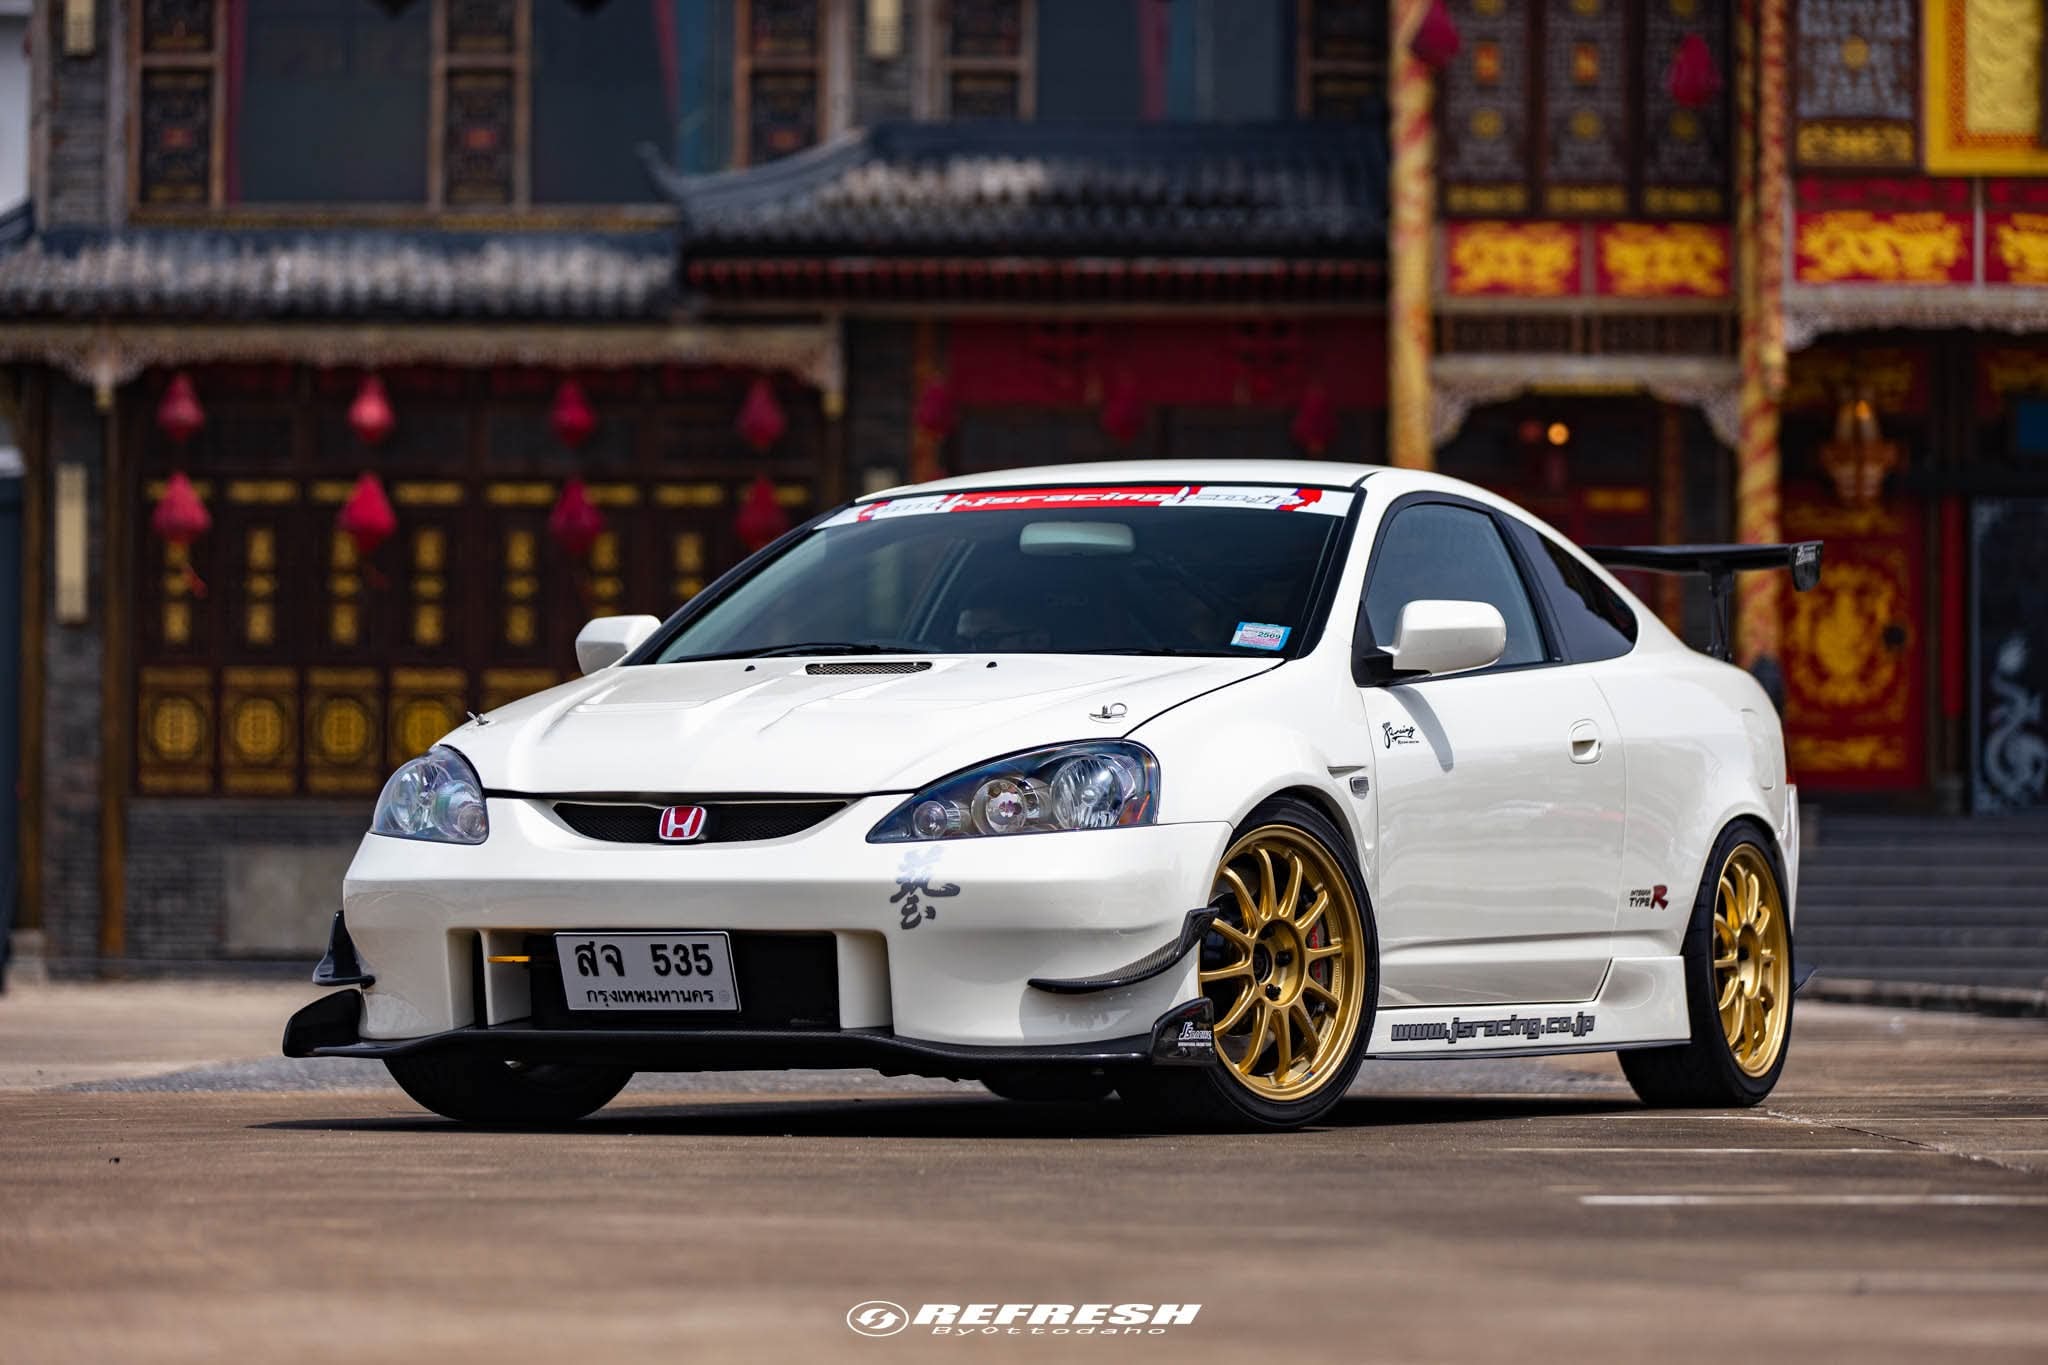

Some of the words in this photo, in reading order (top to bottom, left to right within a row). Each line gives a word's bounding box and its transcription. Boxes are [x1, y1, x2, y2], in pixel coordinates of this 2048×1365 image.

[1629, 897, 1650, 907] TYPE
[1650, 884, 1668, 911] R
[650, 943, 713, 977] 535
[586, 989, 714, 1007] กรุงเทพมหานคร
[1391, 1011, 1596, 1043] www.jsracing.co.jp
